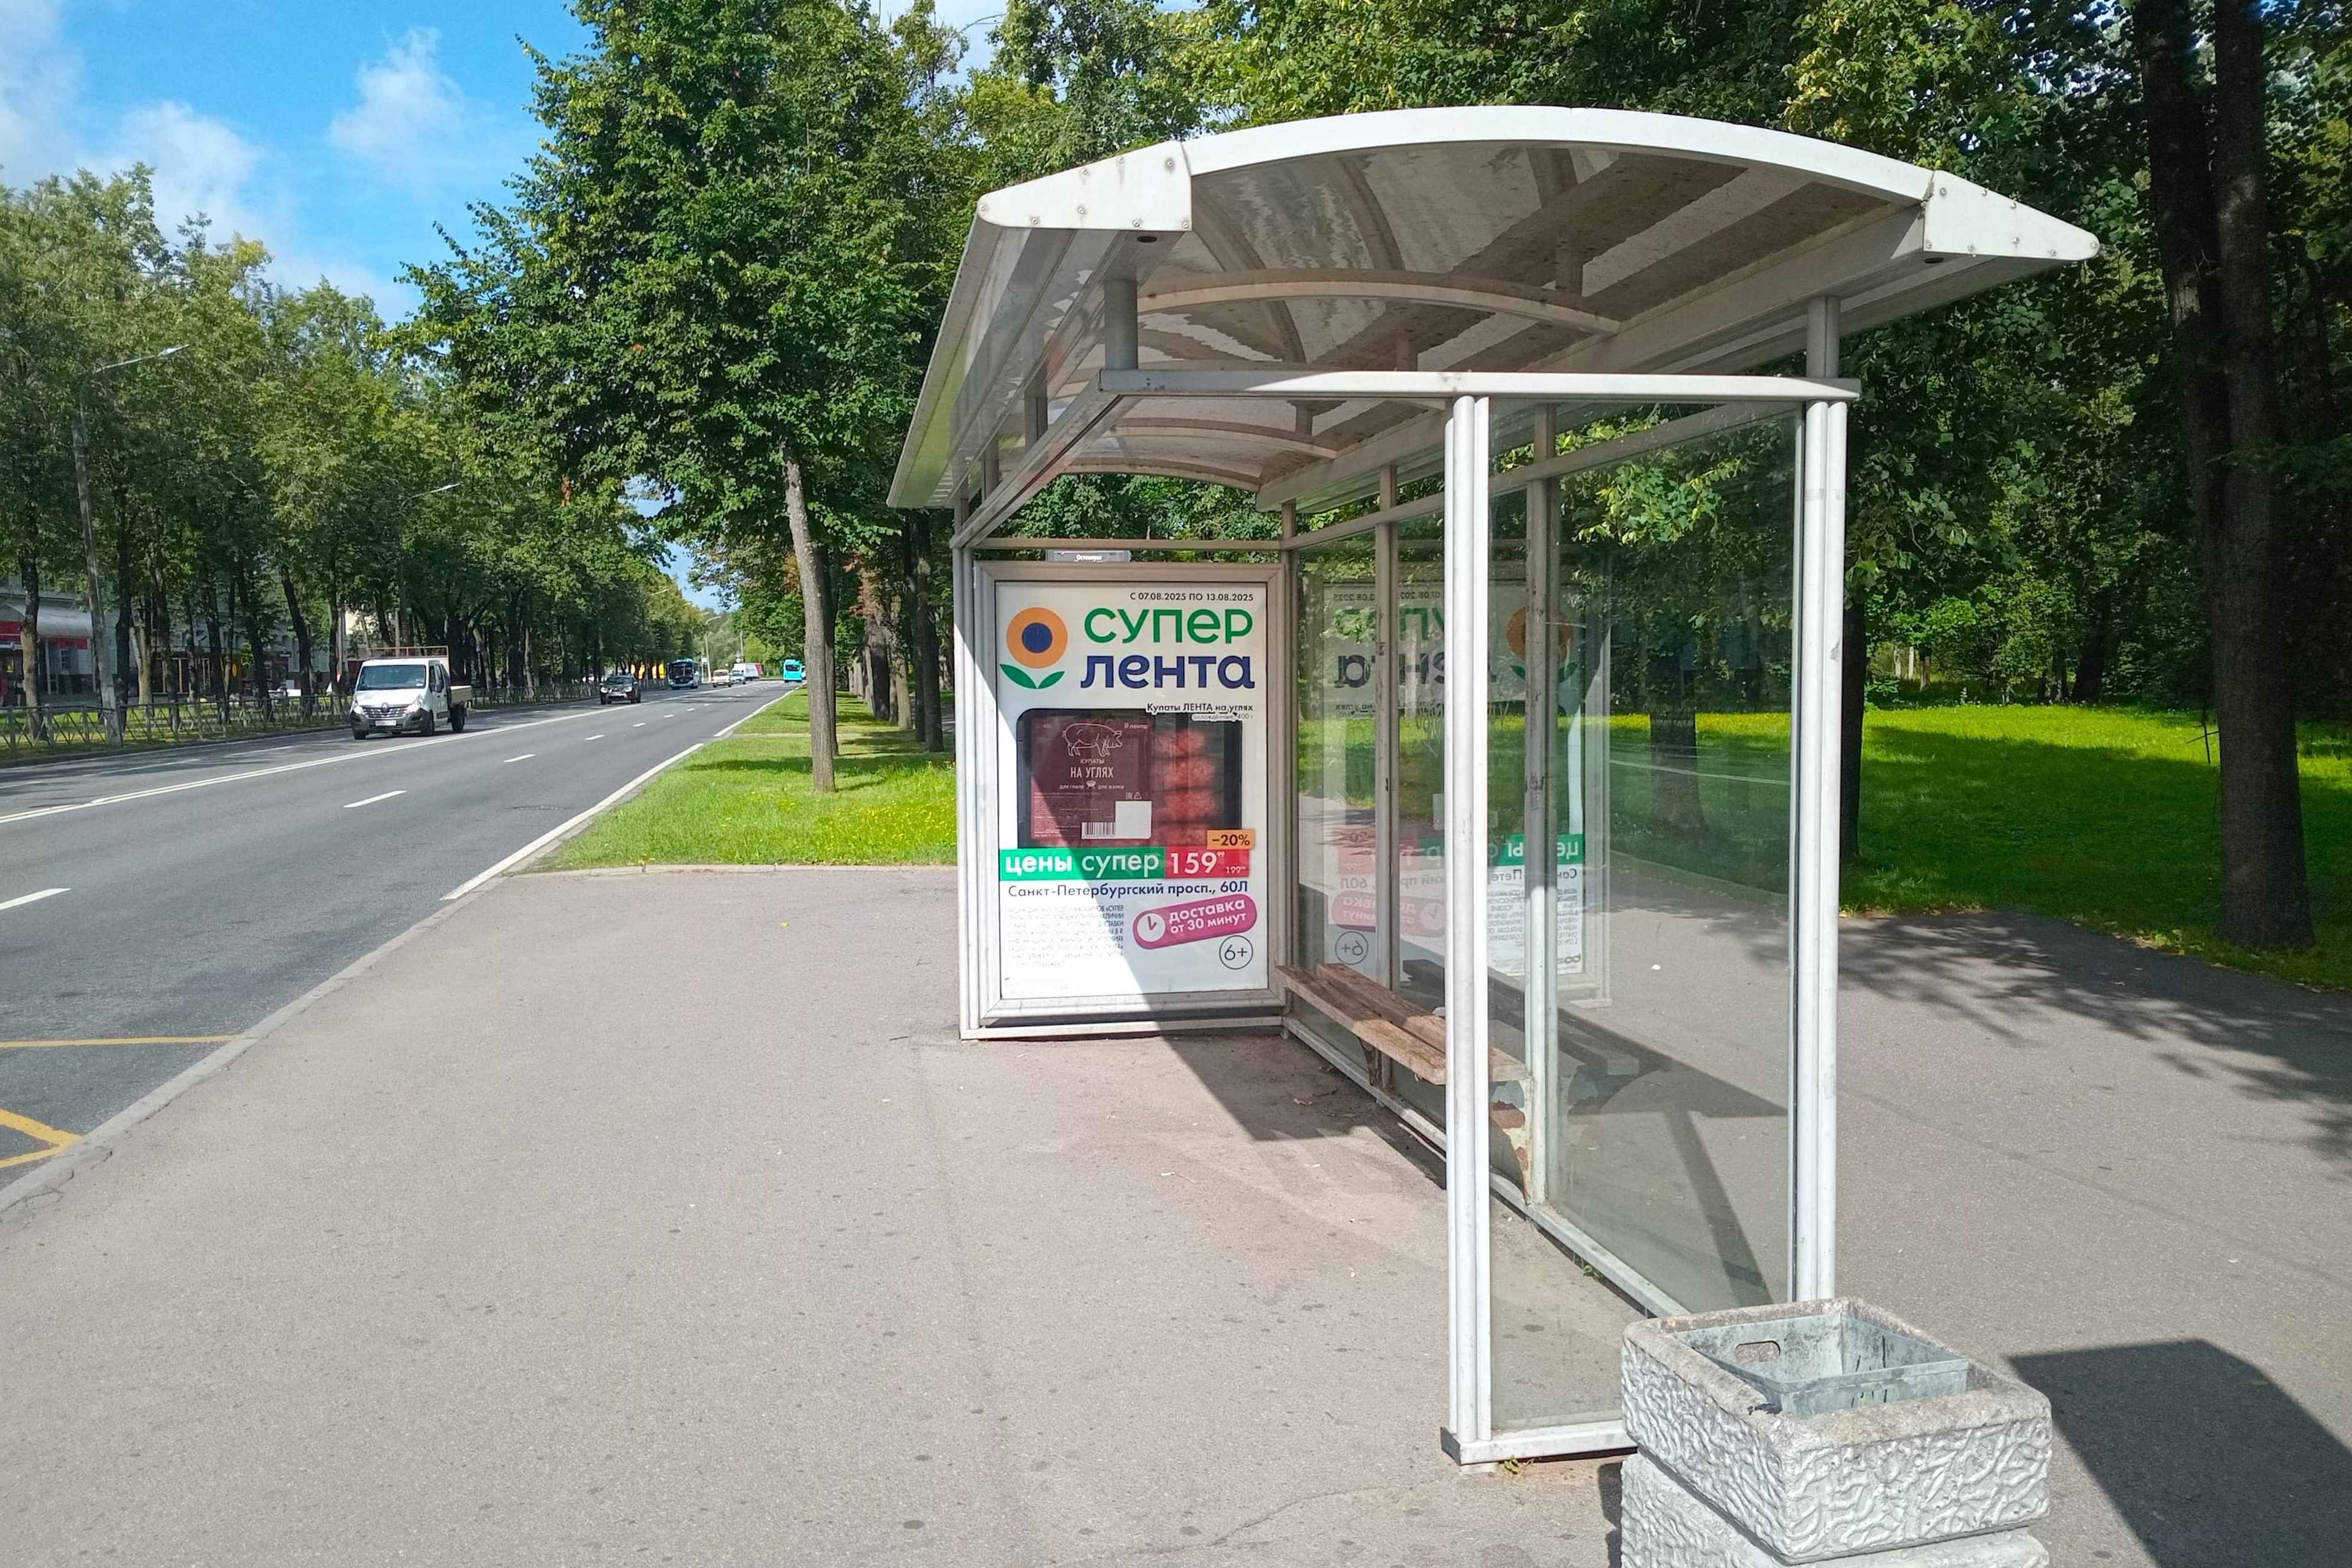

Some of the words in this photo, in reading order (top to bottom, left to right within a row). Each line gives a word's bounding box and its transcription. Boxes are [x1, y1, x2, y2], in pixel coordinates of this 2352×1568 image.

[1084, 608, 1253, 644] супер
[1080, 654, 1255, 688] лента
[1147, 703, 1180, 712] Купаты
[1071, 767, 1082, 778] НА
[1086, 767, 1114, 778] УГЛЯХ
[1005, 854, 1072, 876] цены
[1082, 853, 1159, 878] супер
[1009, 883, 1164, 899] Санкт-Петербургский
[1168, 884, 1216, 897] просп.,
[1220, 881, 1248, 892] 60Л
[1169, 899, 1245, 925] доставка
[1170, 924, 1185, 934] от
[1187, 918, 1204, 931] 30
[1207, 913, 1246, 928] минут
[1224, 944, 1248, 960] 6+
